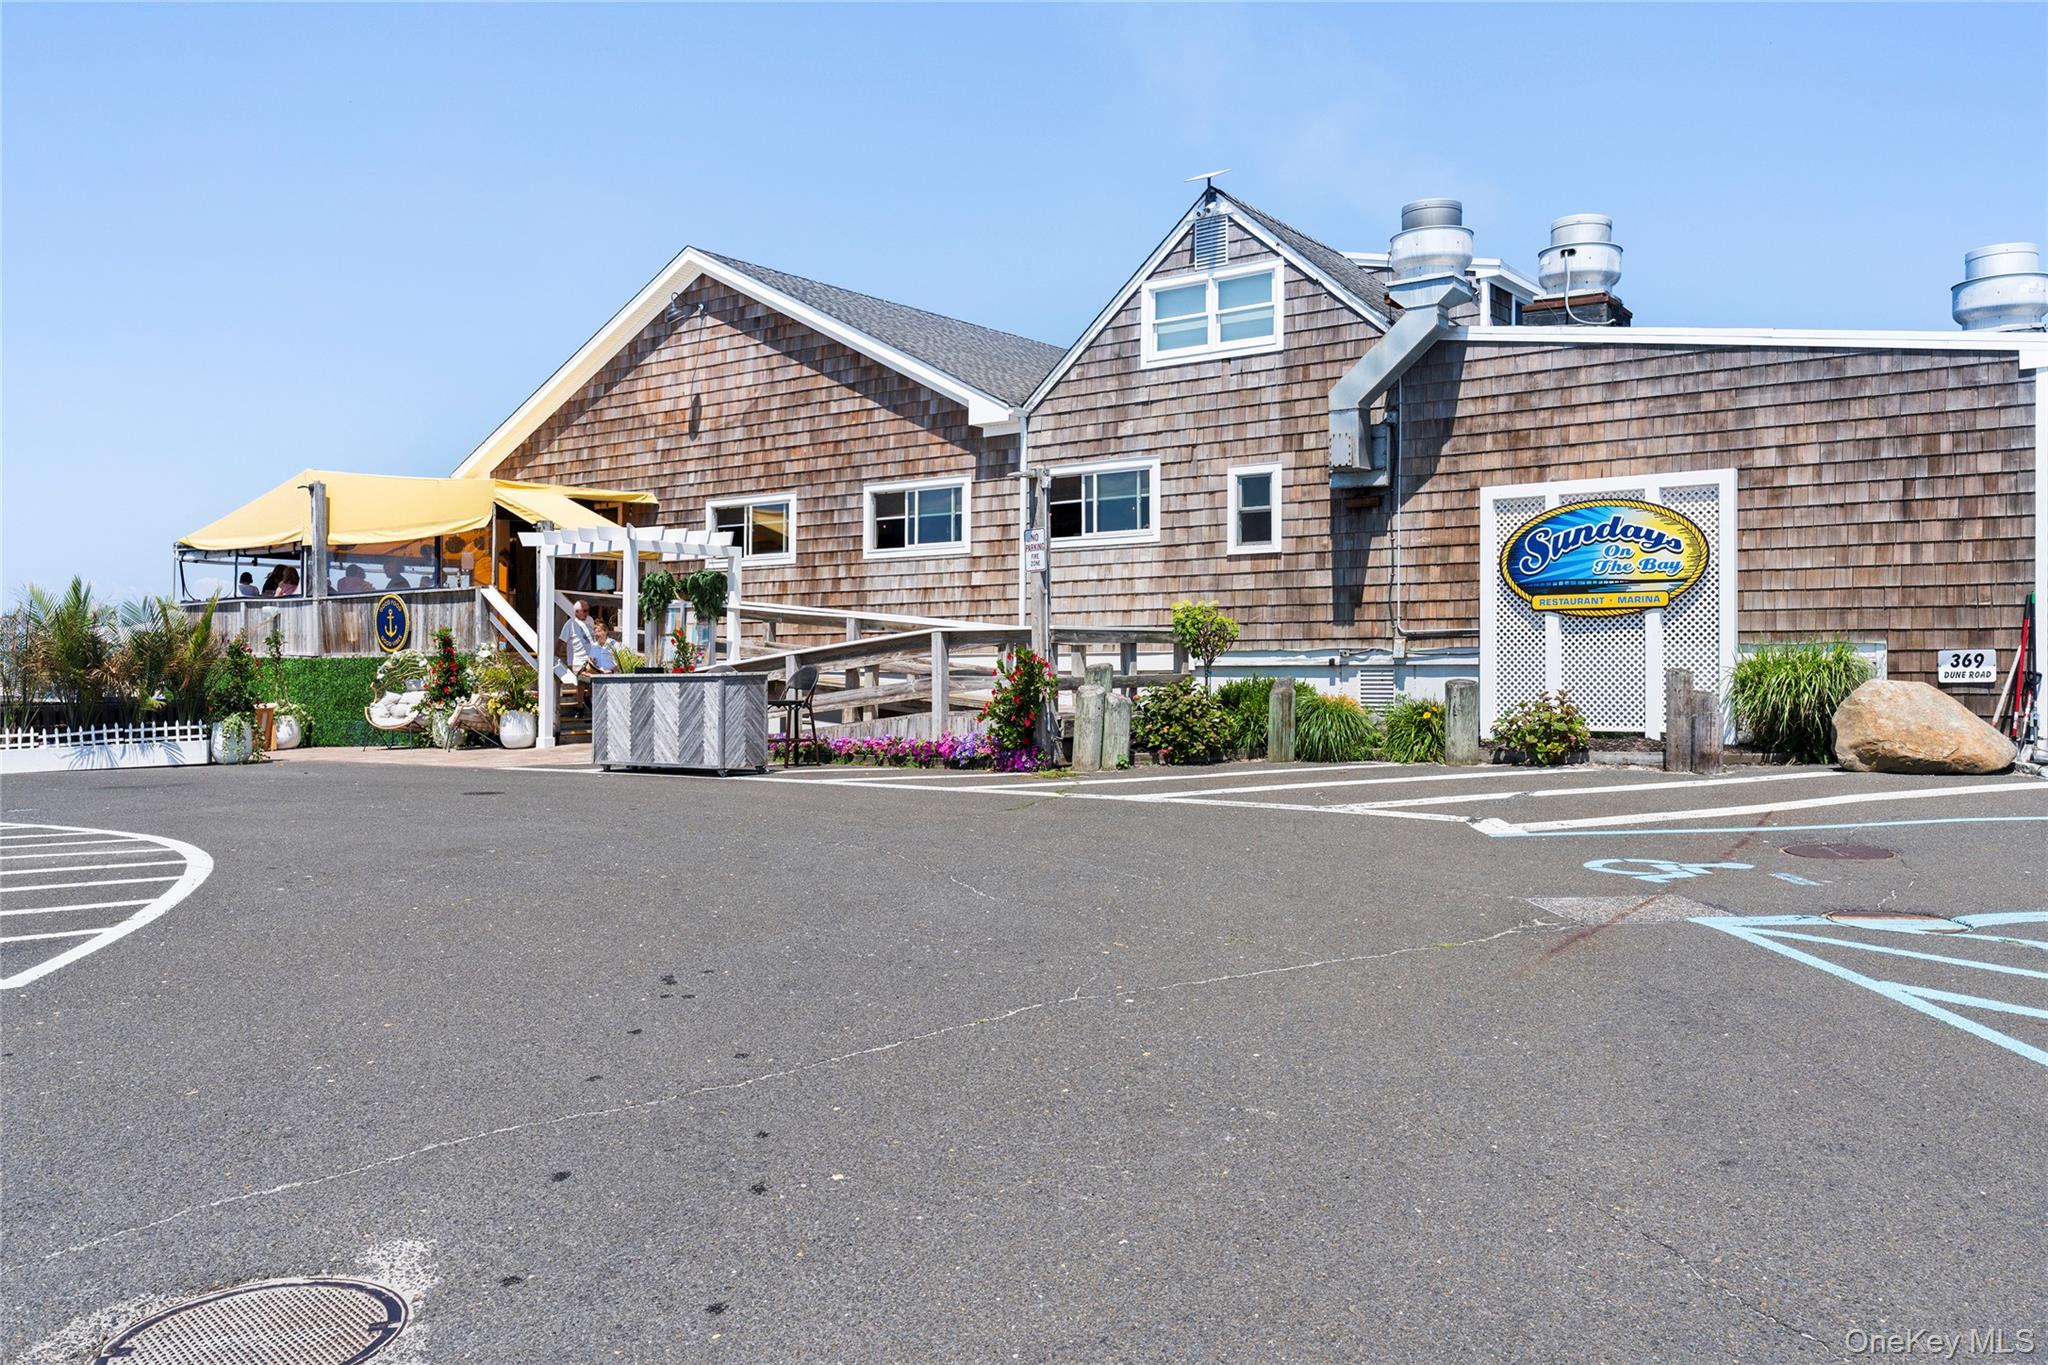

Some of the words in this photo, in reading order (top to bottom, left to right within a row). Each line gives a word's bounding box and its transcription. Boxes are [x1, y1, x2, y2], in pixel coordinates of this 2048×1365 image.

[1031, 533, 1039, 541] NO
[1519, 514, 1684, 574] Sundays
[1025, 543, 1045, 552] PARKING
[1604, 544, 1634, 559] On
[1593, 558, 1634, 575] The
[1638, 557, 1683, 576] Bay
[1539, 597, 1604, 607] RESTAURANT
[1617, 595, 1661, 604] MARINA
[1950, 653, 1985, 668] 369
